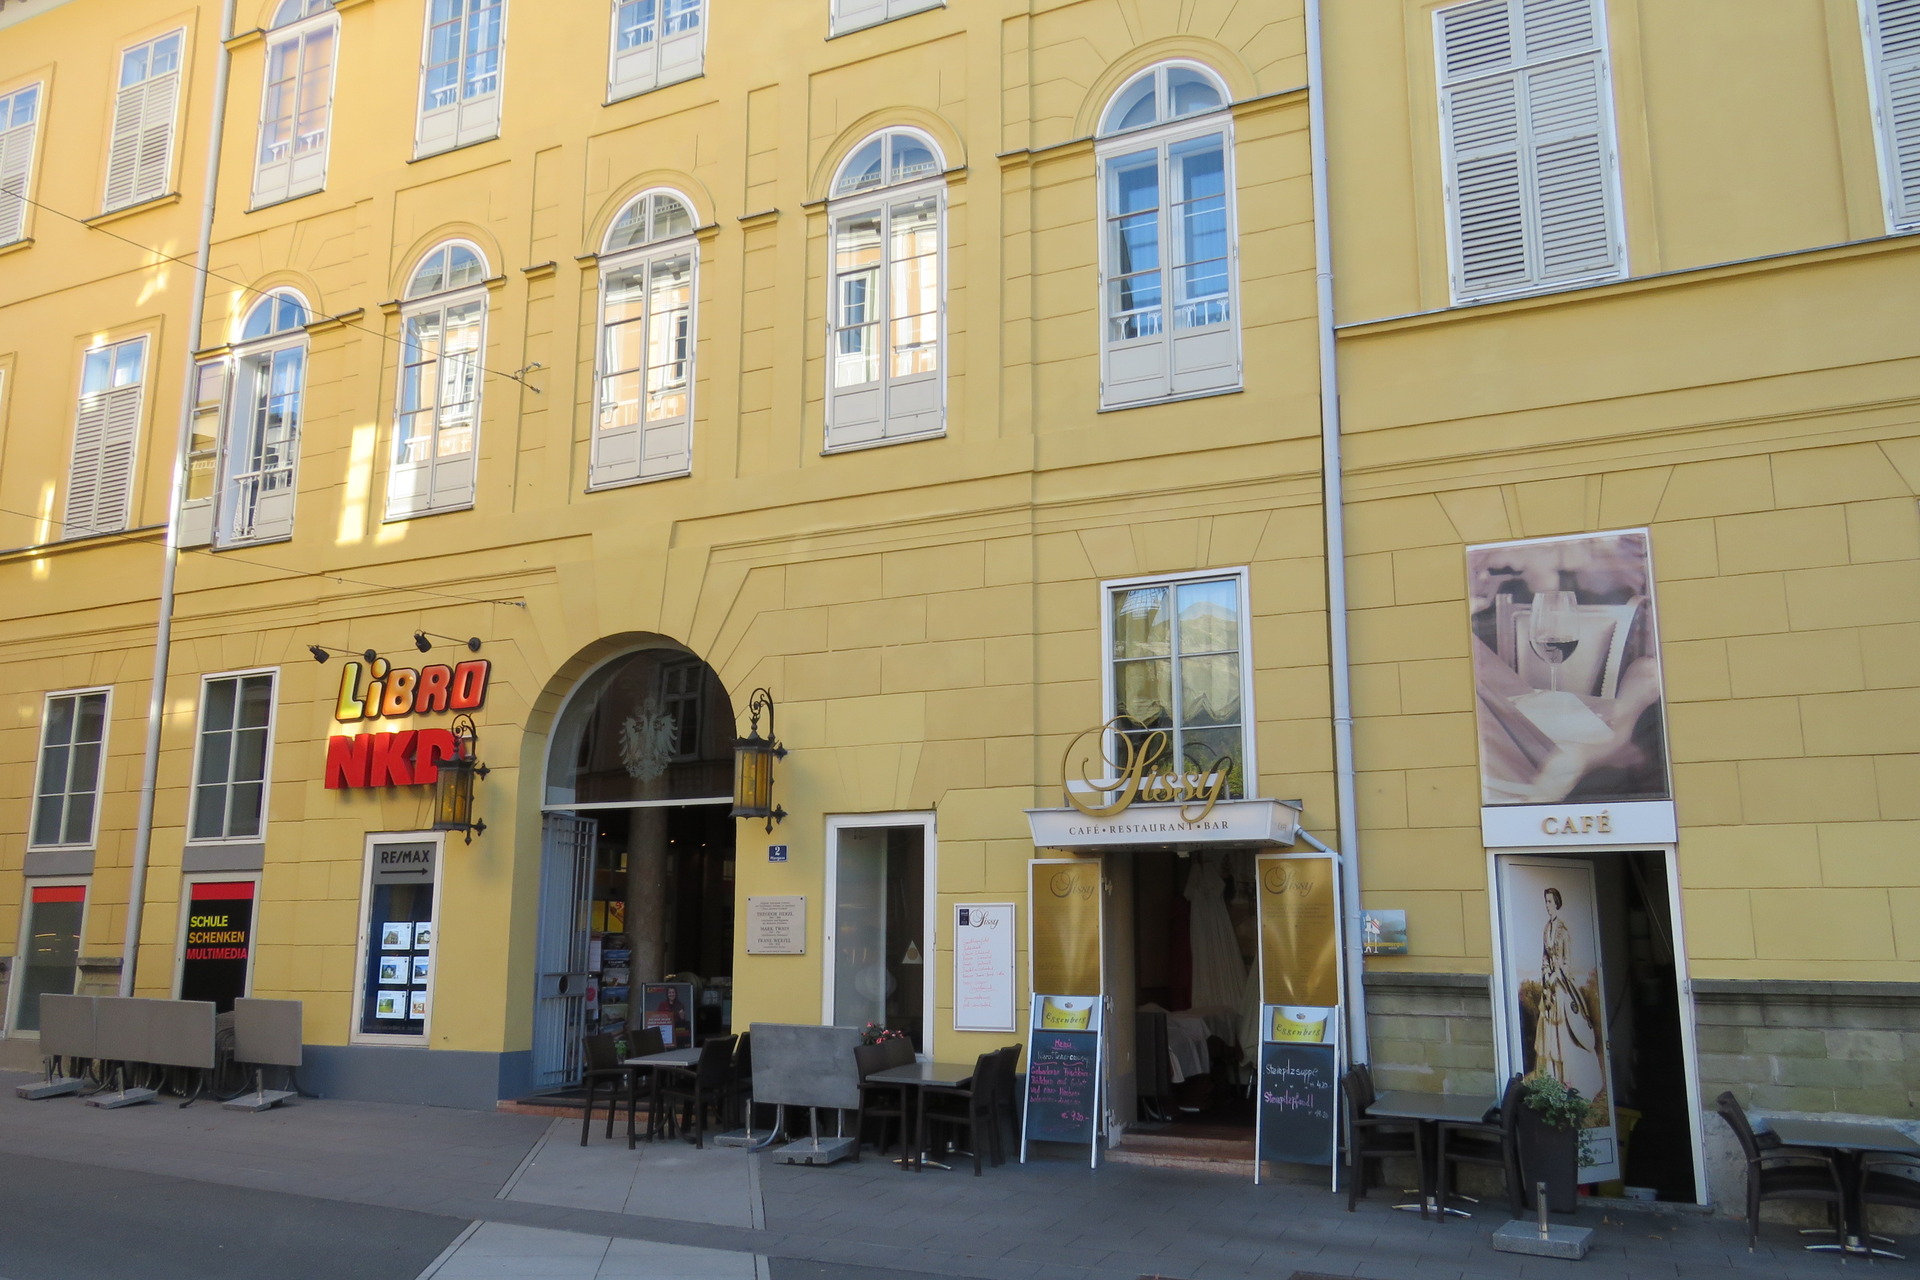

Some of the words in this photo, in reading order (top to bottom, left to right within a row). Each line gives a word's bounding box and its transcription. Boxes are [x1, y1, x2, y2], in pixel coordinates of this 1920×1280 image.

[1061, 715, 1233, 824] Sissy
[1541, 809, 1612, 835] CAFÉ
[381, 850, 430, 863] RE/MAX
[774, 846, 781, 856] 2
[190, 915, 228, 928] SCHULE
[970, 909, 999, 930] Sissy
[188, 931, 245, 944] SCHENKEN
[186, 947, 249, 960] MULTIMEDIA
[1046, 1012, 1086, 1024] Eggenberg
[1276, 1023, 1321, 1036] Eggenberg
